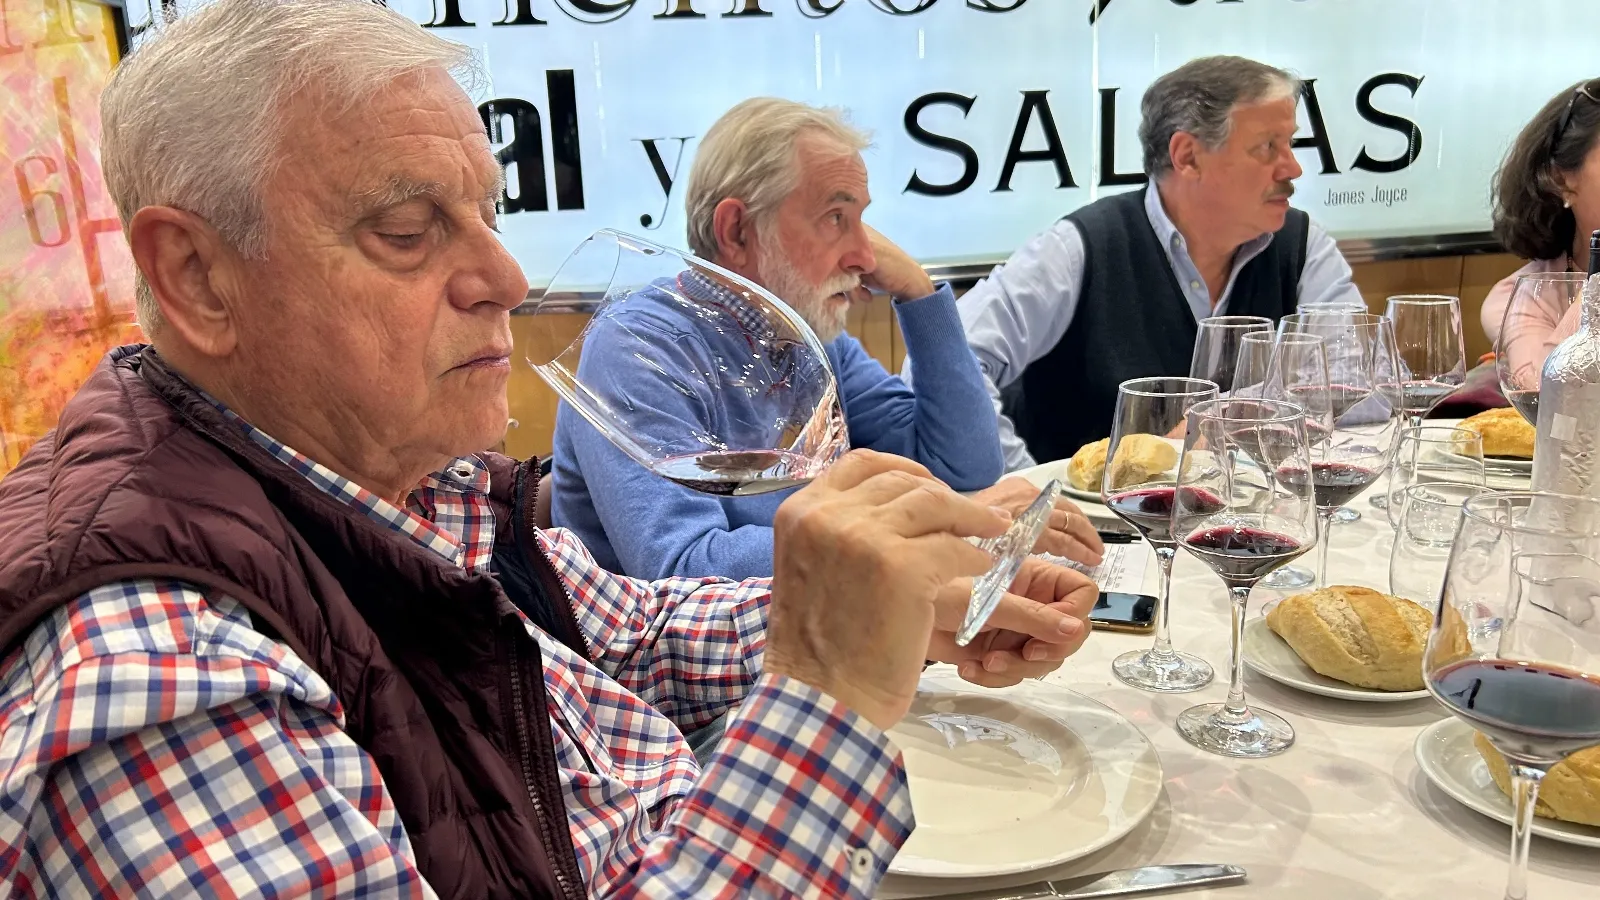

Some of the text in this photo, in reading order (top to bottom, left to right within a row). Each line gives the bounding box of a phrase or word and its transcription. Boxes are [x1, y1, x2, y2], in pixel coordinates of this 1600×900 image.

[630, 136, 696, 230] y
[901, 73, 1425, 197] SALAS
[1324, 185, 1407, 207] James Joyce
